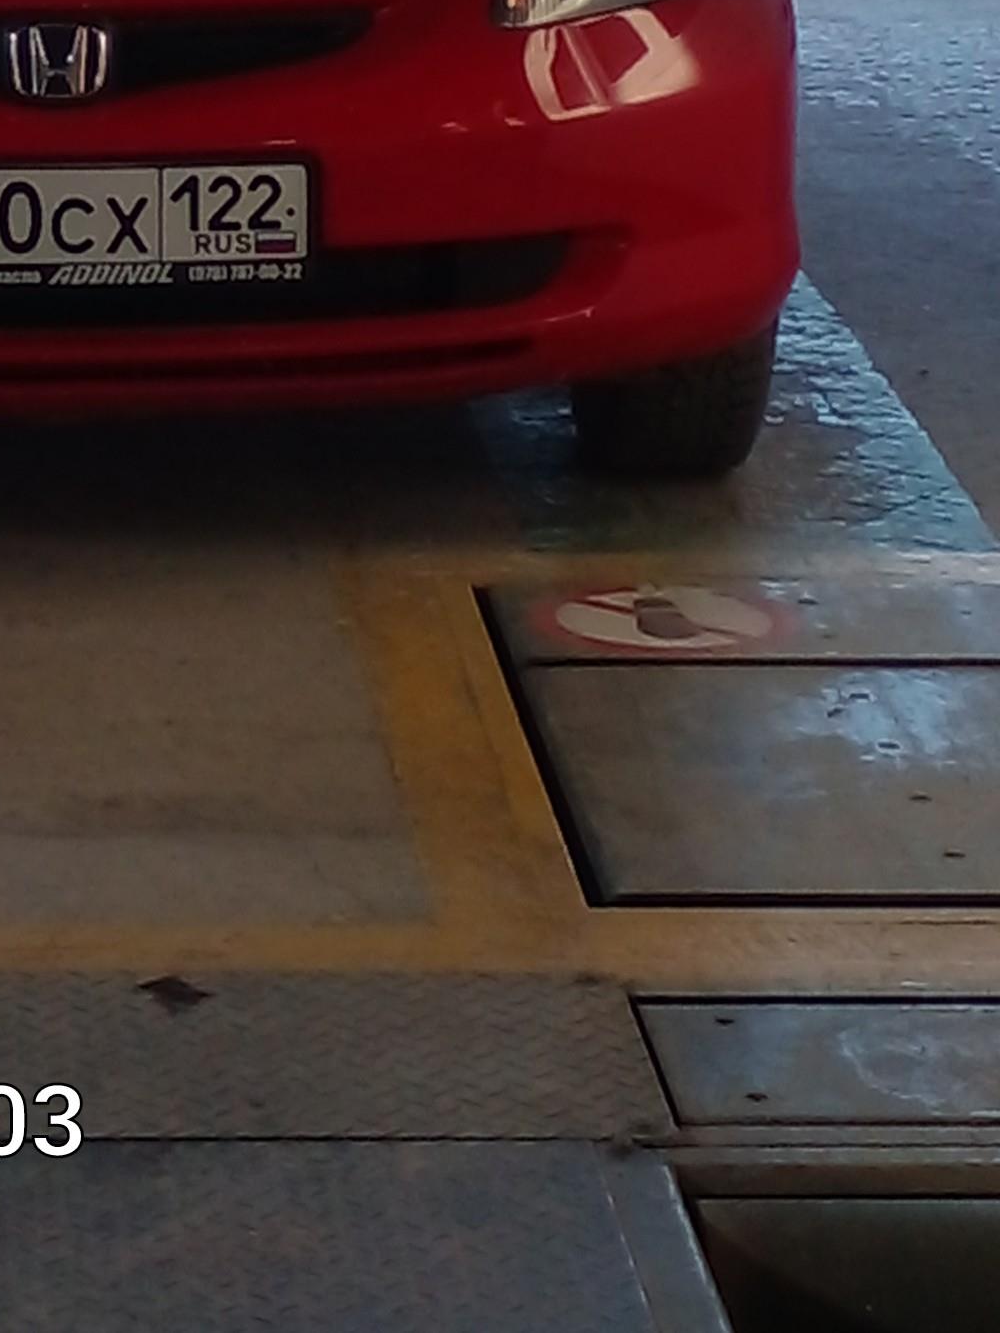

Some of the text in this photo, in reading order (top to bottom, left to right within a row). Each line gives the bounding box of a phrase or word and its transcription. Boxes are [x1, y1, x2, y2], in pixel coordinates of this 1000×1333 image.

[169, 174, 283, 232] 122
[194, 233, 252, 255] RUS
[47, 263, 174, 285] ADDINOL
